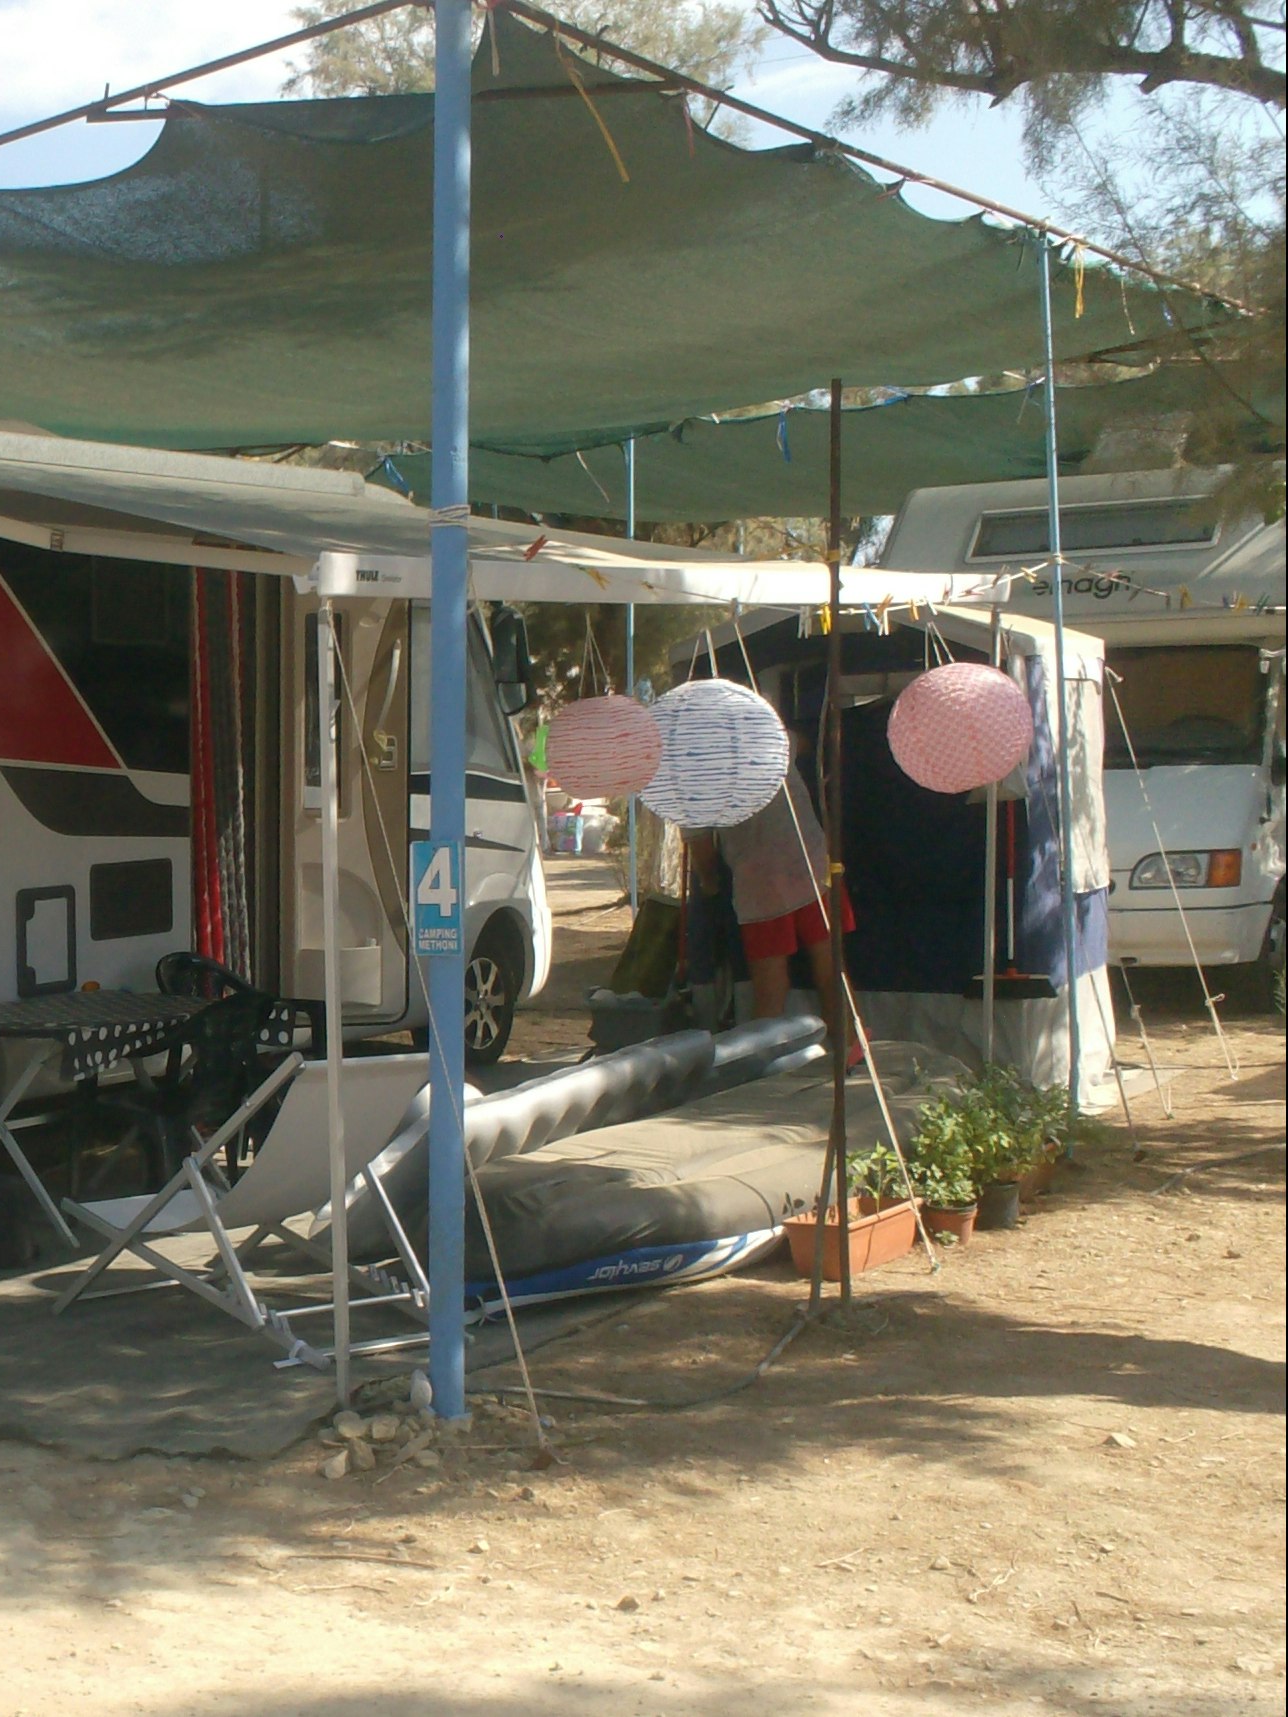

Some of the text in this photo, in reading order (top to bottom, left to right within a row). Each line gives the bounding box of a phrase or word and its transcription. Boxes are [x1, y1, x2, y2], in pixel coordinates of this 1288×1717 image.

[418, 847, 457, 917] 4
[418, 928, 457, 939] CAMPING
[418, 940, 458, 950] METHONI
